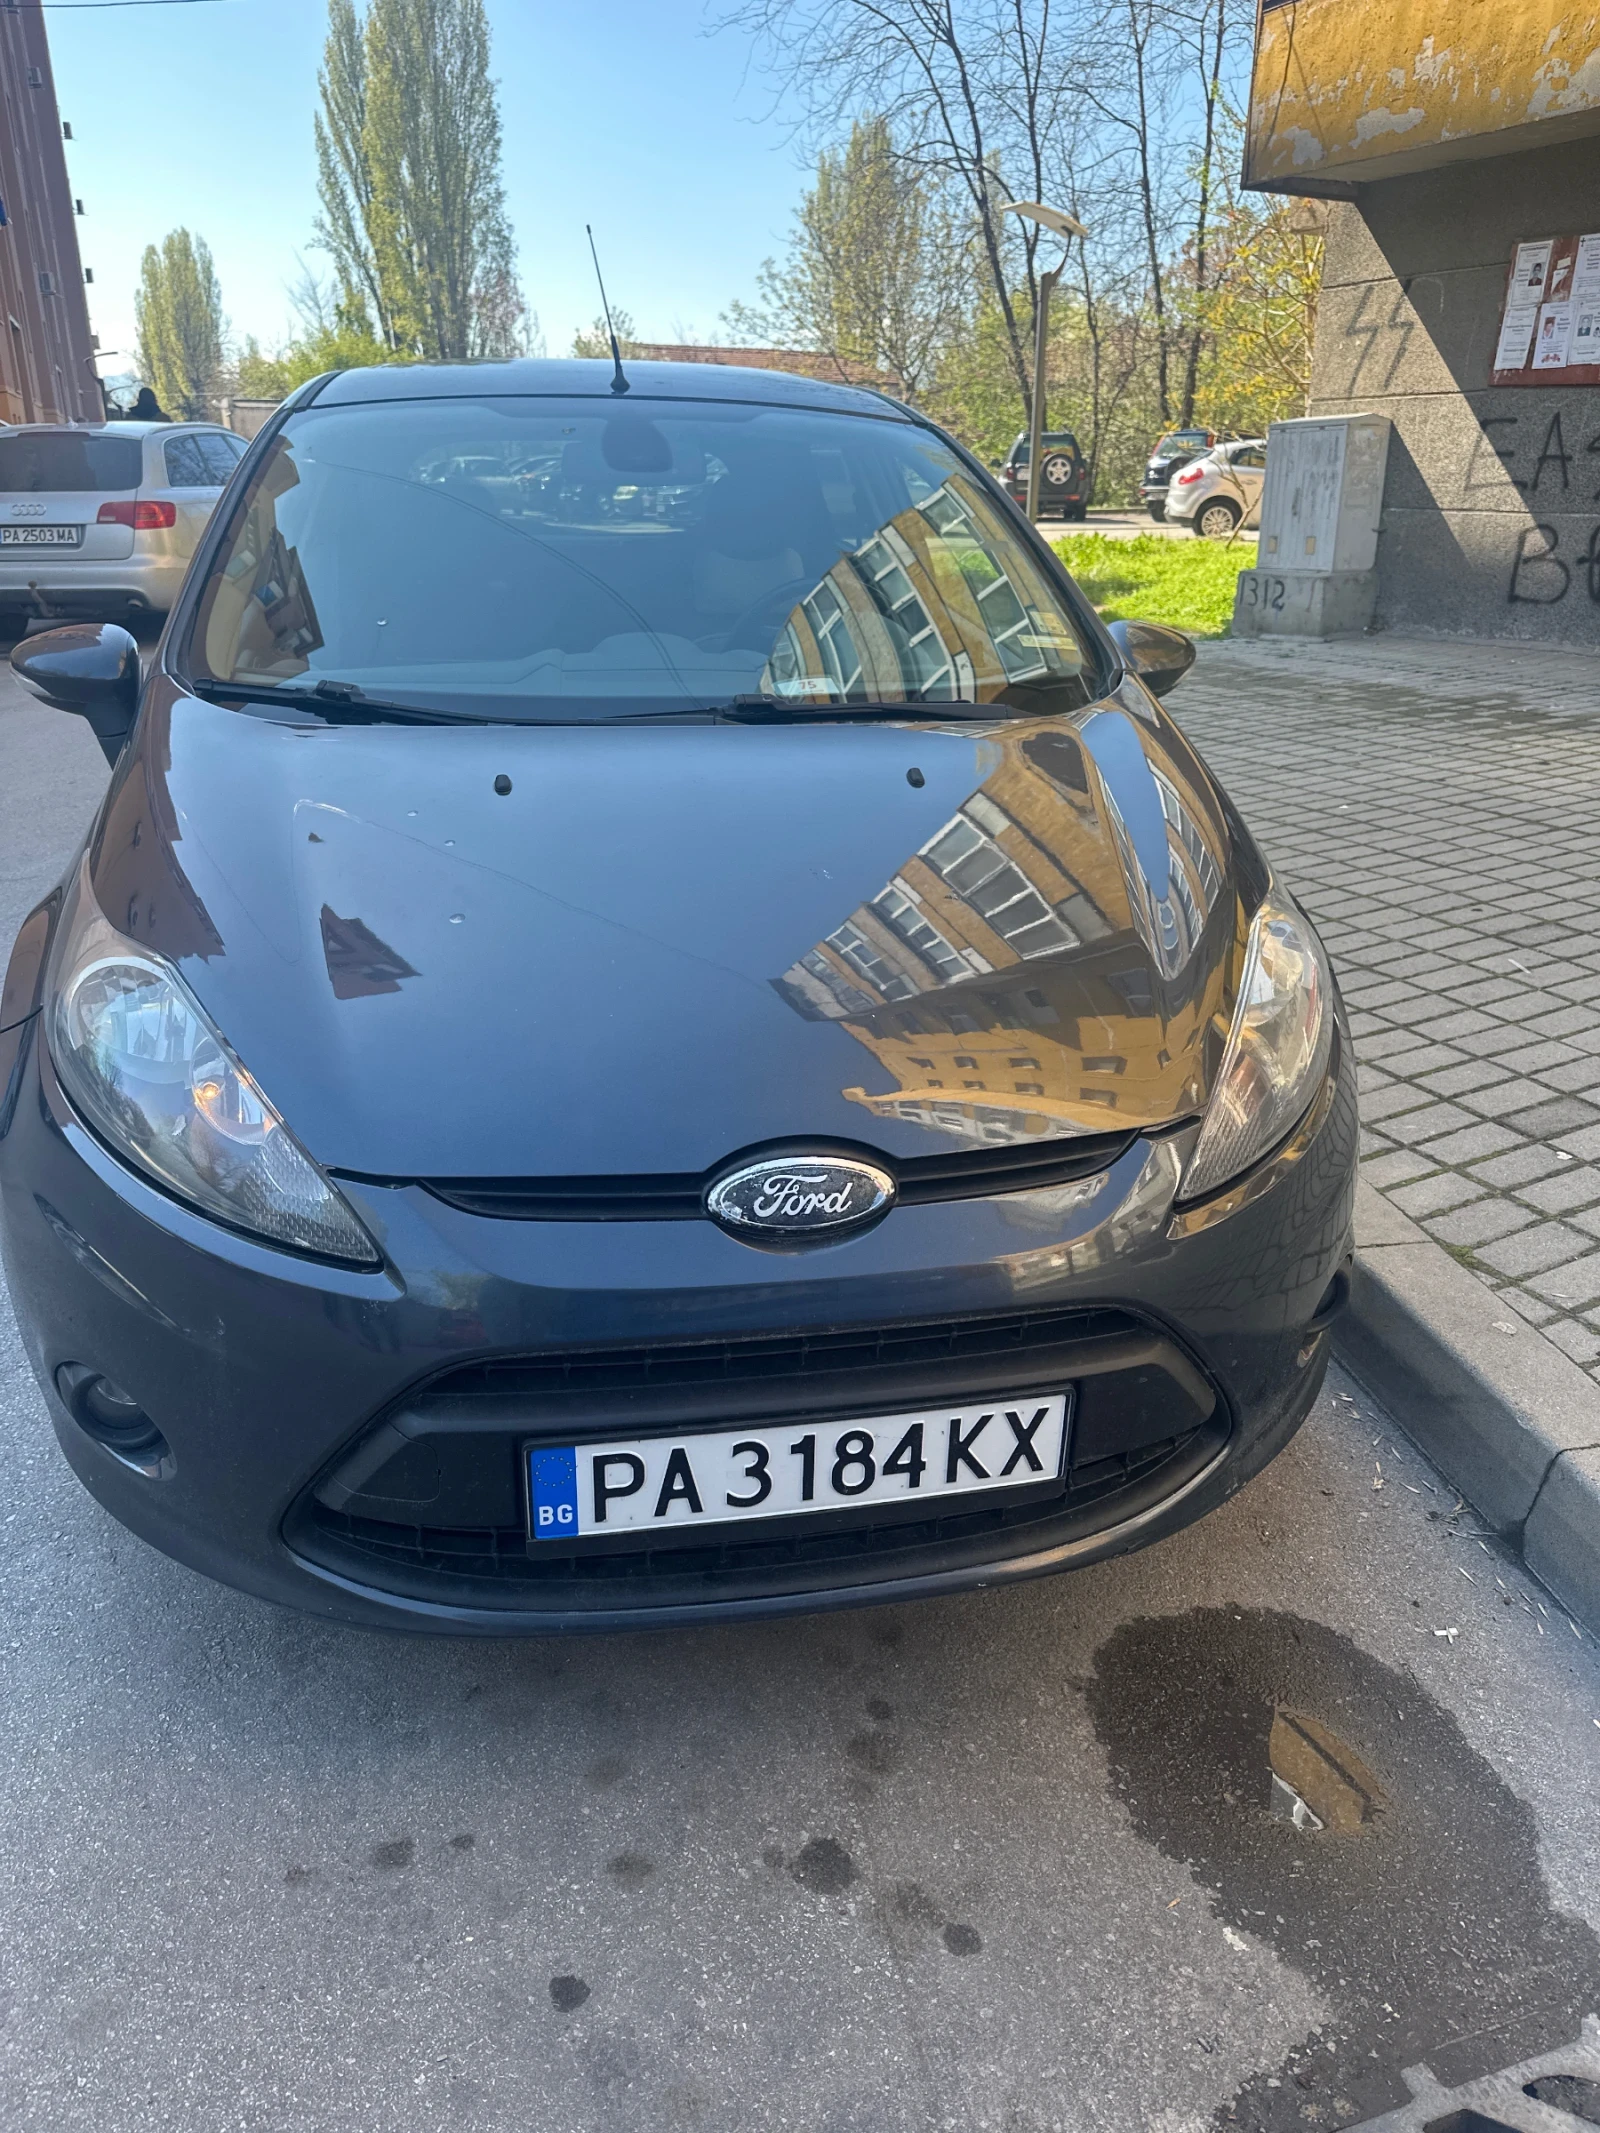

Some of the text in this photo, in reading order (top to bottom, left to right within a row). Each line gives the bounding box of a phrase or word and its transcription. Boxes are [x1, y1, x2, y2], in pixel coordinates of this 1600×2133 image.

[2, 528, 75, 542] PA 2503 MA
[1239, 577, 1286, 611] 1312
[753, 1174, 853, 1218] Ford
[592, 1406, 1050, 1523] PA 3184 KX
[538, 1504, 574, 1526] BG
